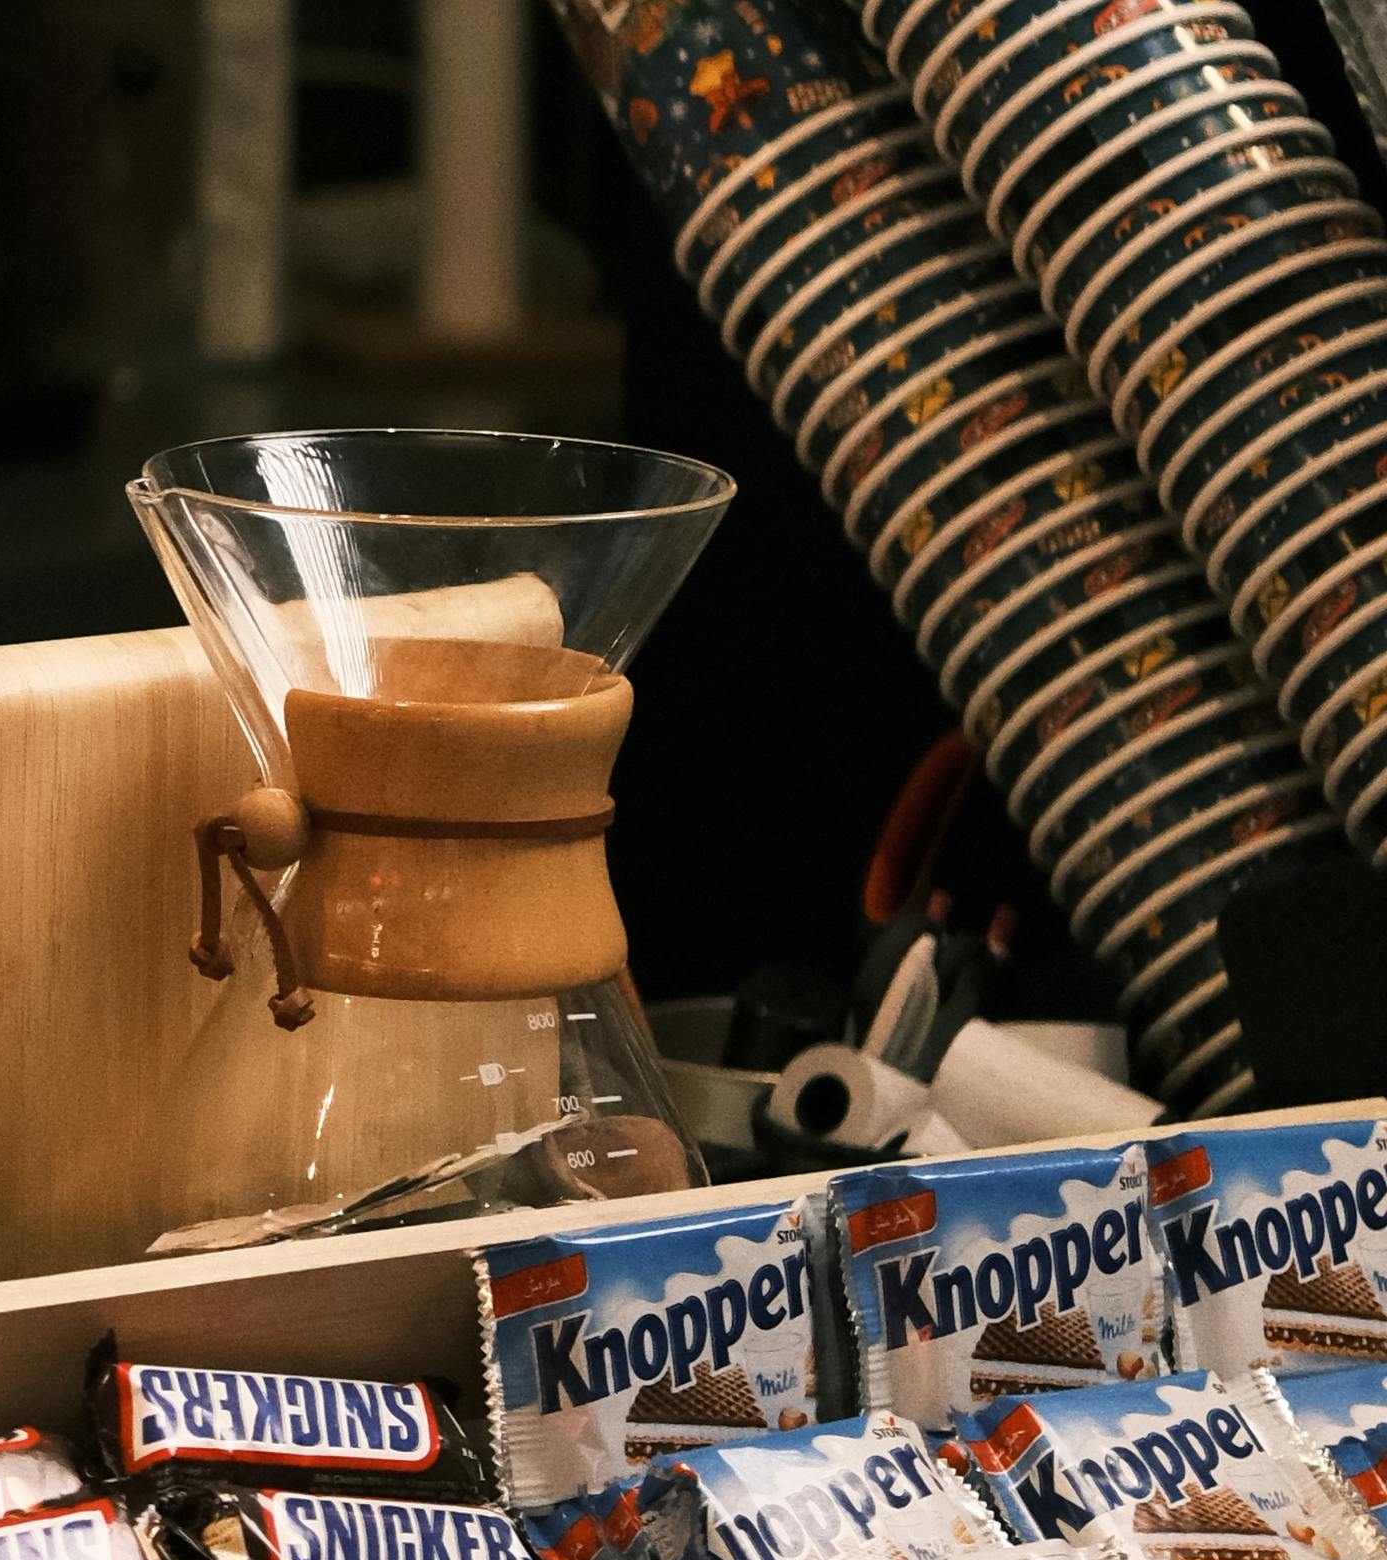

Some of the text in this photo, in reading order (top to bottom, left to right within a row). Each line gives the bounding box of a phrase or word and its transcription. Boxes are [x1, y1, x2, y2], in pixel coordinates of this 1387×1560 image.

[527, 1012, 556, 1030] 800
[552, 1094, 580, 1113] 700
[567, 1149, 596, 1169] 600
[879, 1194, 1144, 1351] Knopper
[1163, 1166, 1387, 1308] Knoppe
[533, 1247, 812, 1415] Knopper
[139, 1367, 421, 1454] SNICKERS
